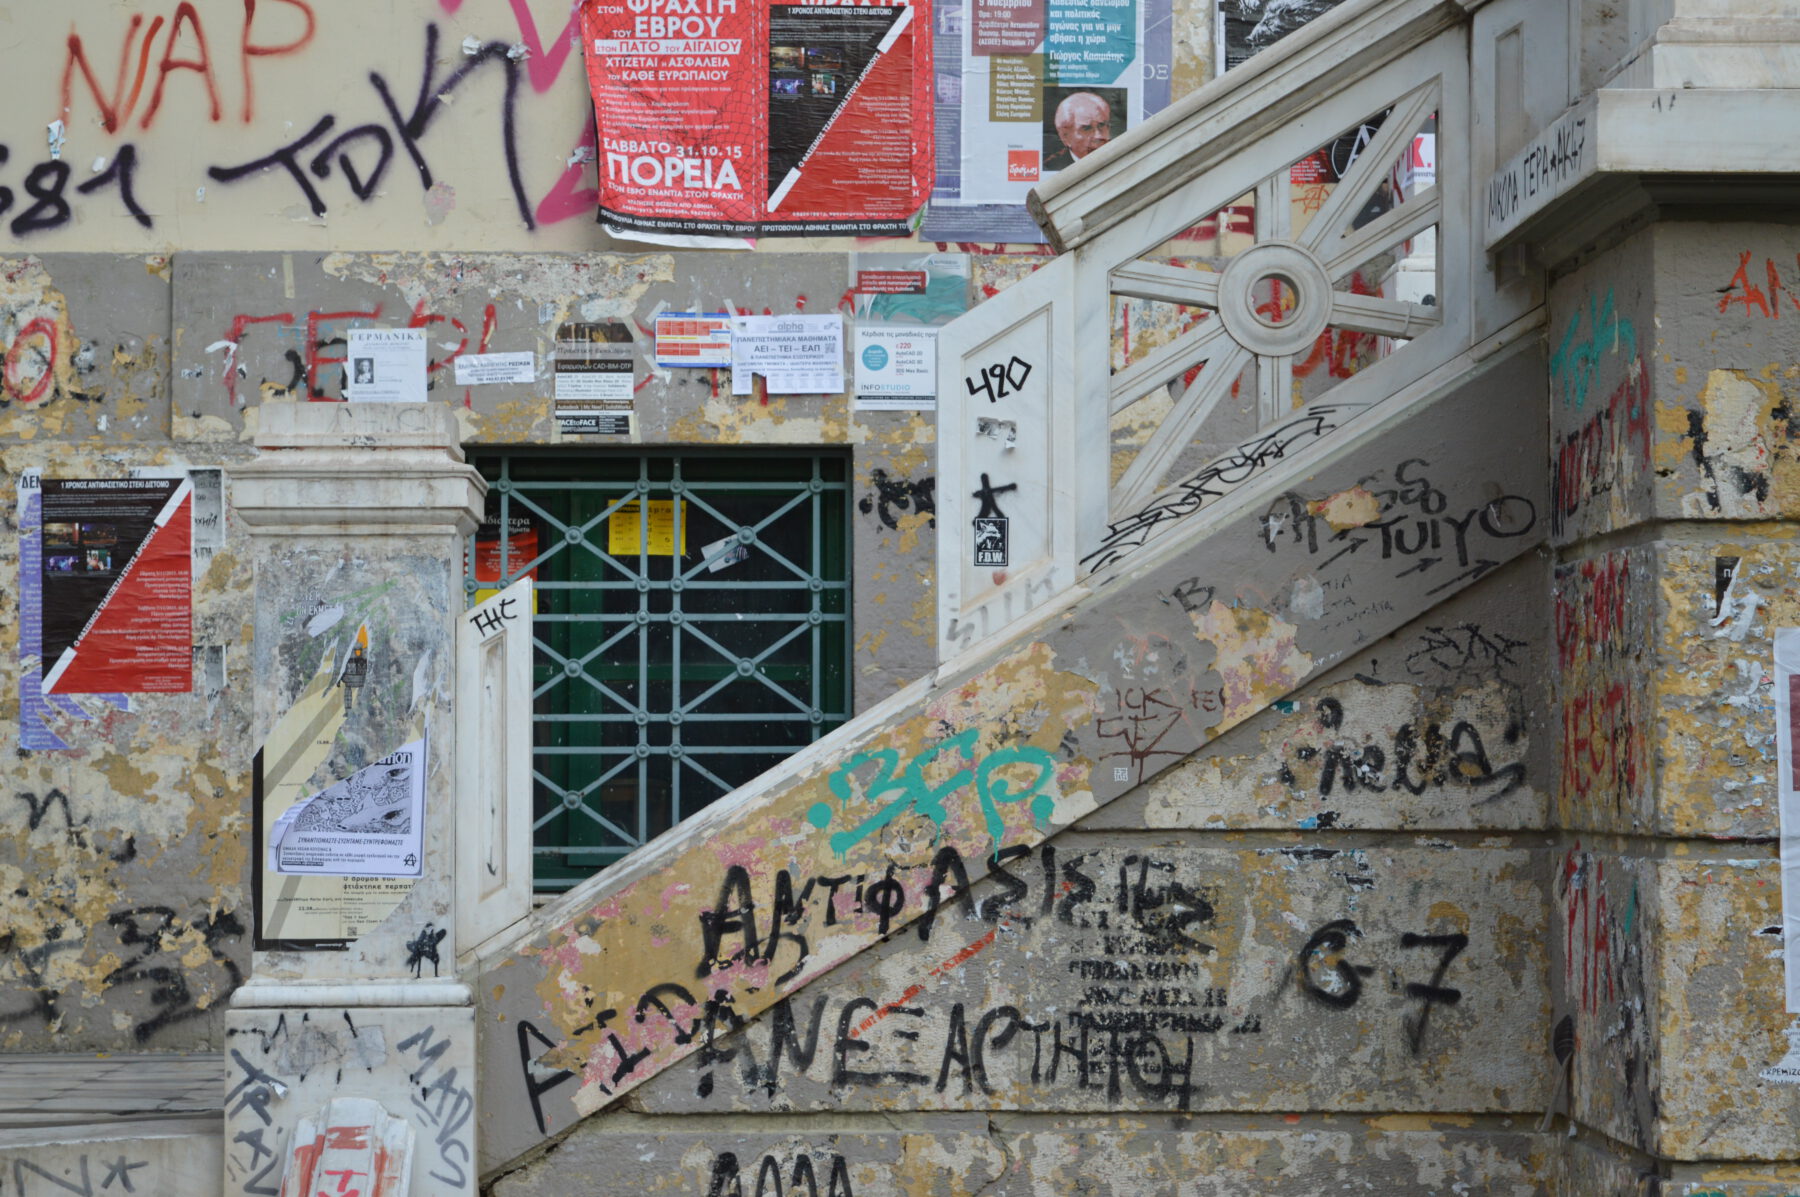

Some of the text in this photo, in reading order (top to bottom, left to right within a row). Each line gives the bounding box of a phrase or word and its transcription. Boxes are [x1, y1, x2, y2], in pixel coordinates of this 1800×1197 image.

[597, 6, 624, 14] ΣΤΟΝ
[1050, 10, 1100, 19] και πολιτικός
[612, 16, 723, 38] ΤΟΥ ΕΒΡΟΥ
[1050, 22, 1121, 33] αγώνας για να μην
[1050, 34, 1106, 44] σβήσει η χώρα
[619, 41, 660, 52] ΠΑΤΟ
[683, 41, 740, 52] ΑΙΓΑΙΟΥ
[605, 57, 658, 67] ΧΤΙΖΕΤΑΙ
[668, 57, 730, 67] ΑΣΦΑΛΕΙΑ
[1050, 51, 1124, 63] Γιώργος Κασιμάτης
[622, 70, 654, 81] ΚΑΘΕ
[659, 71, 728, 81] ΕΥΡΩΠΑΙΟΥ
[603, 138, 742, 158] ΣΑΒΒΑΤΟ 31.10.15
[607, 152, 742, 190] ΠΟΡΕΙΑ
[608, 181, 744, 200] ΣΤΟΝ ΕΒΡΟ ΕΝΑΝΤΙΑ ΣΤΟΝ ΦΡΑΧΤΗ
[657, 221, 683, 229] ΕΝΑΝΤΙΑ
[697, 223, 721, 231] ΦΡΑΧΤΗ
[777, 322, 804, 332] alpha
[350, 332, 424, 341] ΓΕΡΜΑΝΙΚΑ
[801, 344, 821, 352] ΕΑΠ
[965, 356, 1032, 402] 420
